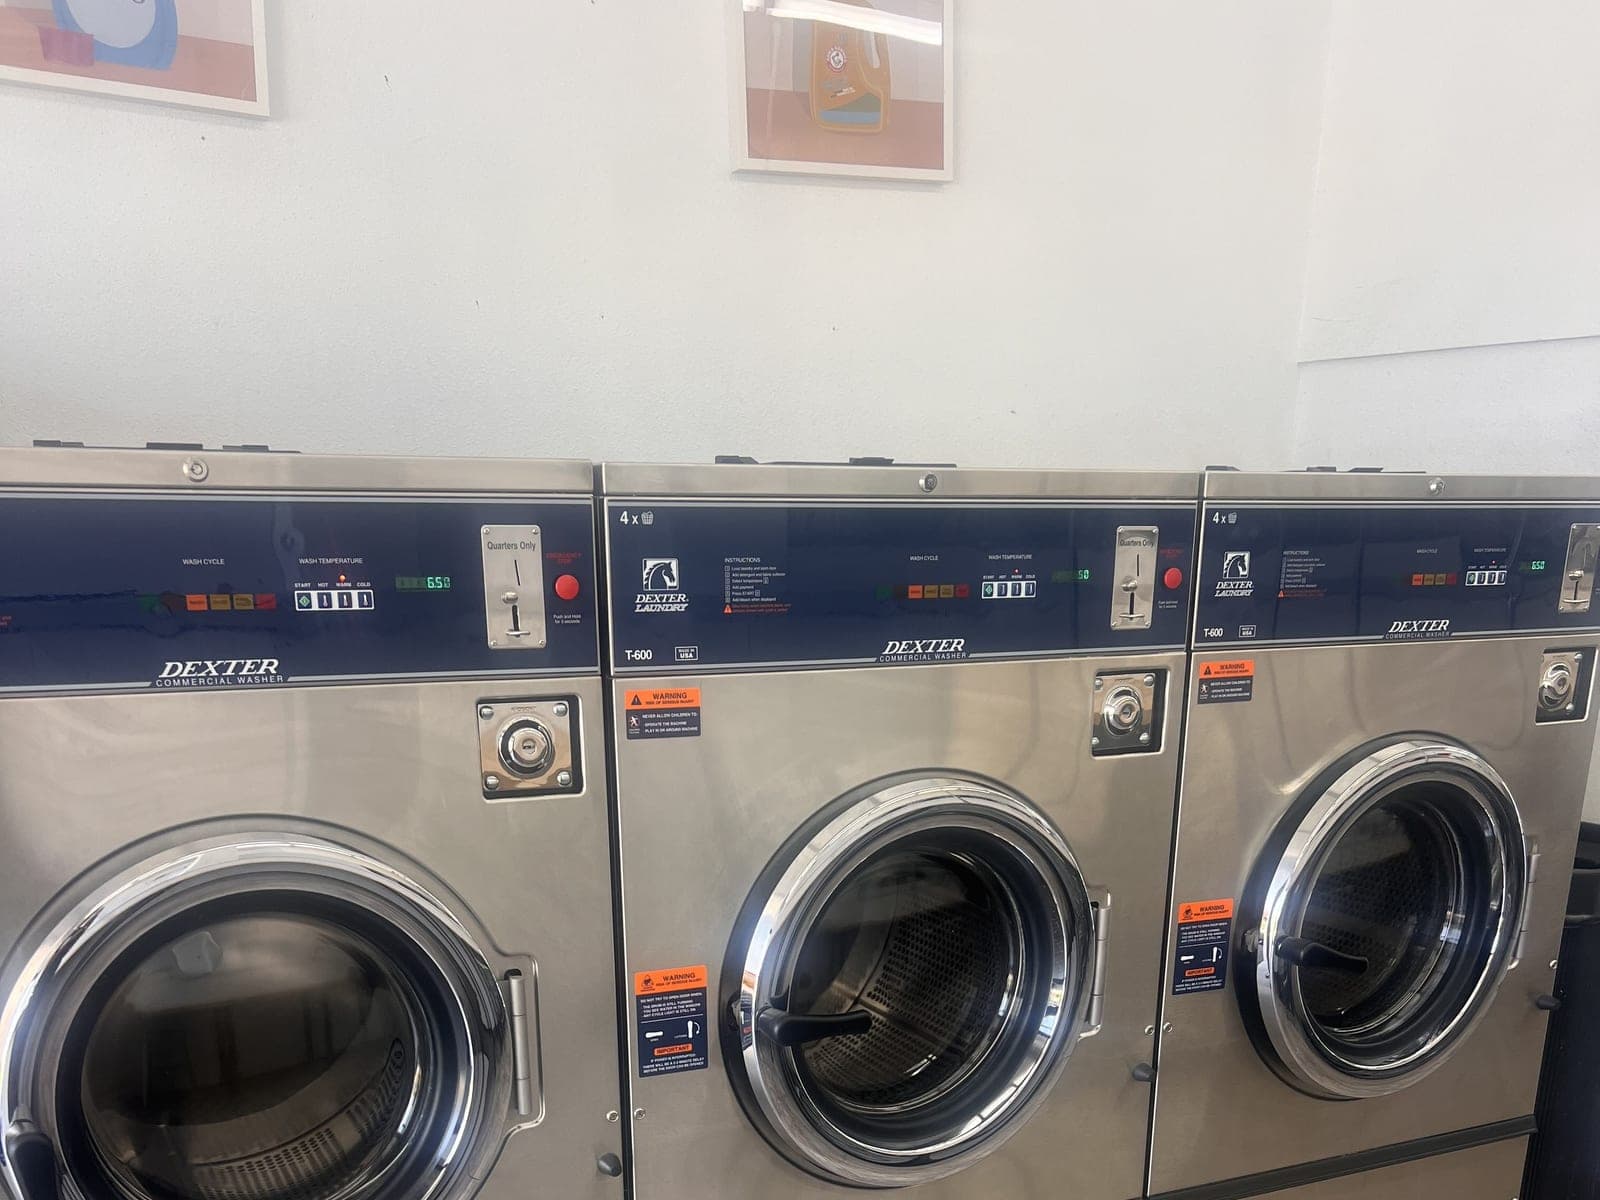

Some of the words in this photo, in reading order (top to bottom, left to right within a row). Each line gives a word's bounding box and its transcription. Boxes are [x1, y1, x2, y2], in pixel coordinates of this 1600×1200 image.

[620, 511, 629, 525] 4
[632, 515, 639, 524] x
[1213, 512, 1219, 523] 4
[487, 541, 518, 550] Quarters
[520, 541, 536, 551] Only
[1216, 581, 1253, 589] DEXTER
[635, 594, 687, 603] DEXTER
[635, 604, 688, 612] LAUNDRY
[1388, 620, 1449, 632] DEXTER
[1204, 628, 1223, 637] T-600
[882, 639, 965, 654] DEXTER
[625, 650, 652, 660] T-600
[880, 654, 931, 662] COMMERCIAL
[159, 659, 279, 678] DEXTER
[156, 677, 232, 687] COMMERCIAL
[238, 675, 283, 683] WASHER
[663, 973, 696, 981] WARNING
[656, 1046, 689, 1054] IMPORTANT
